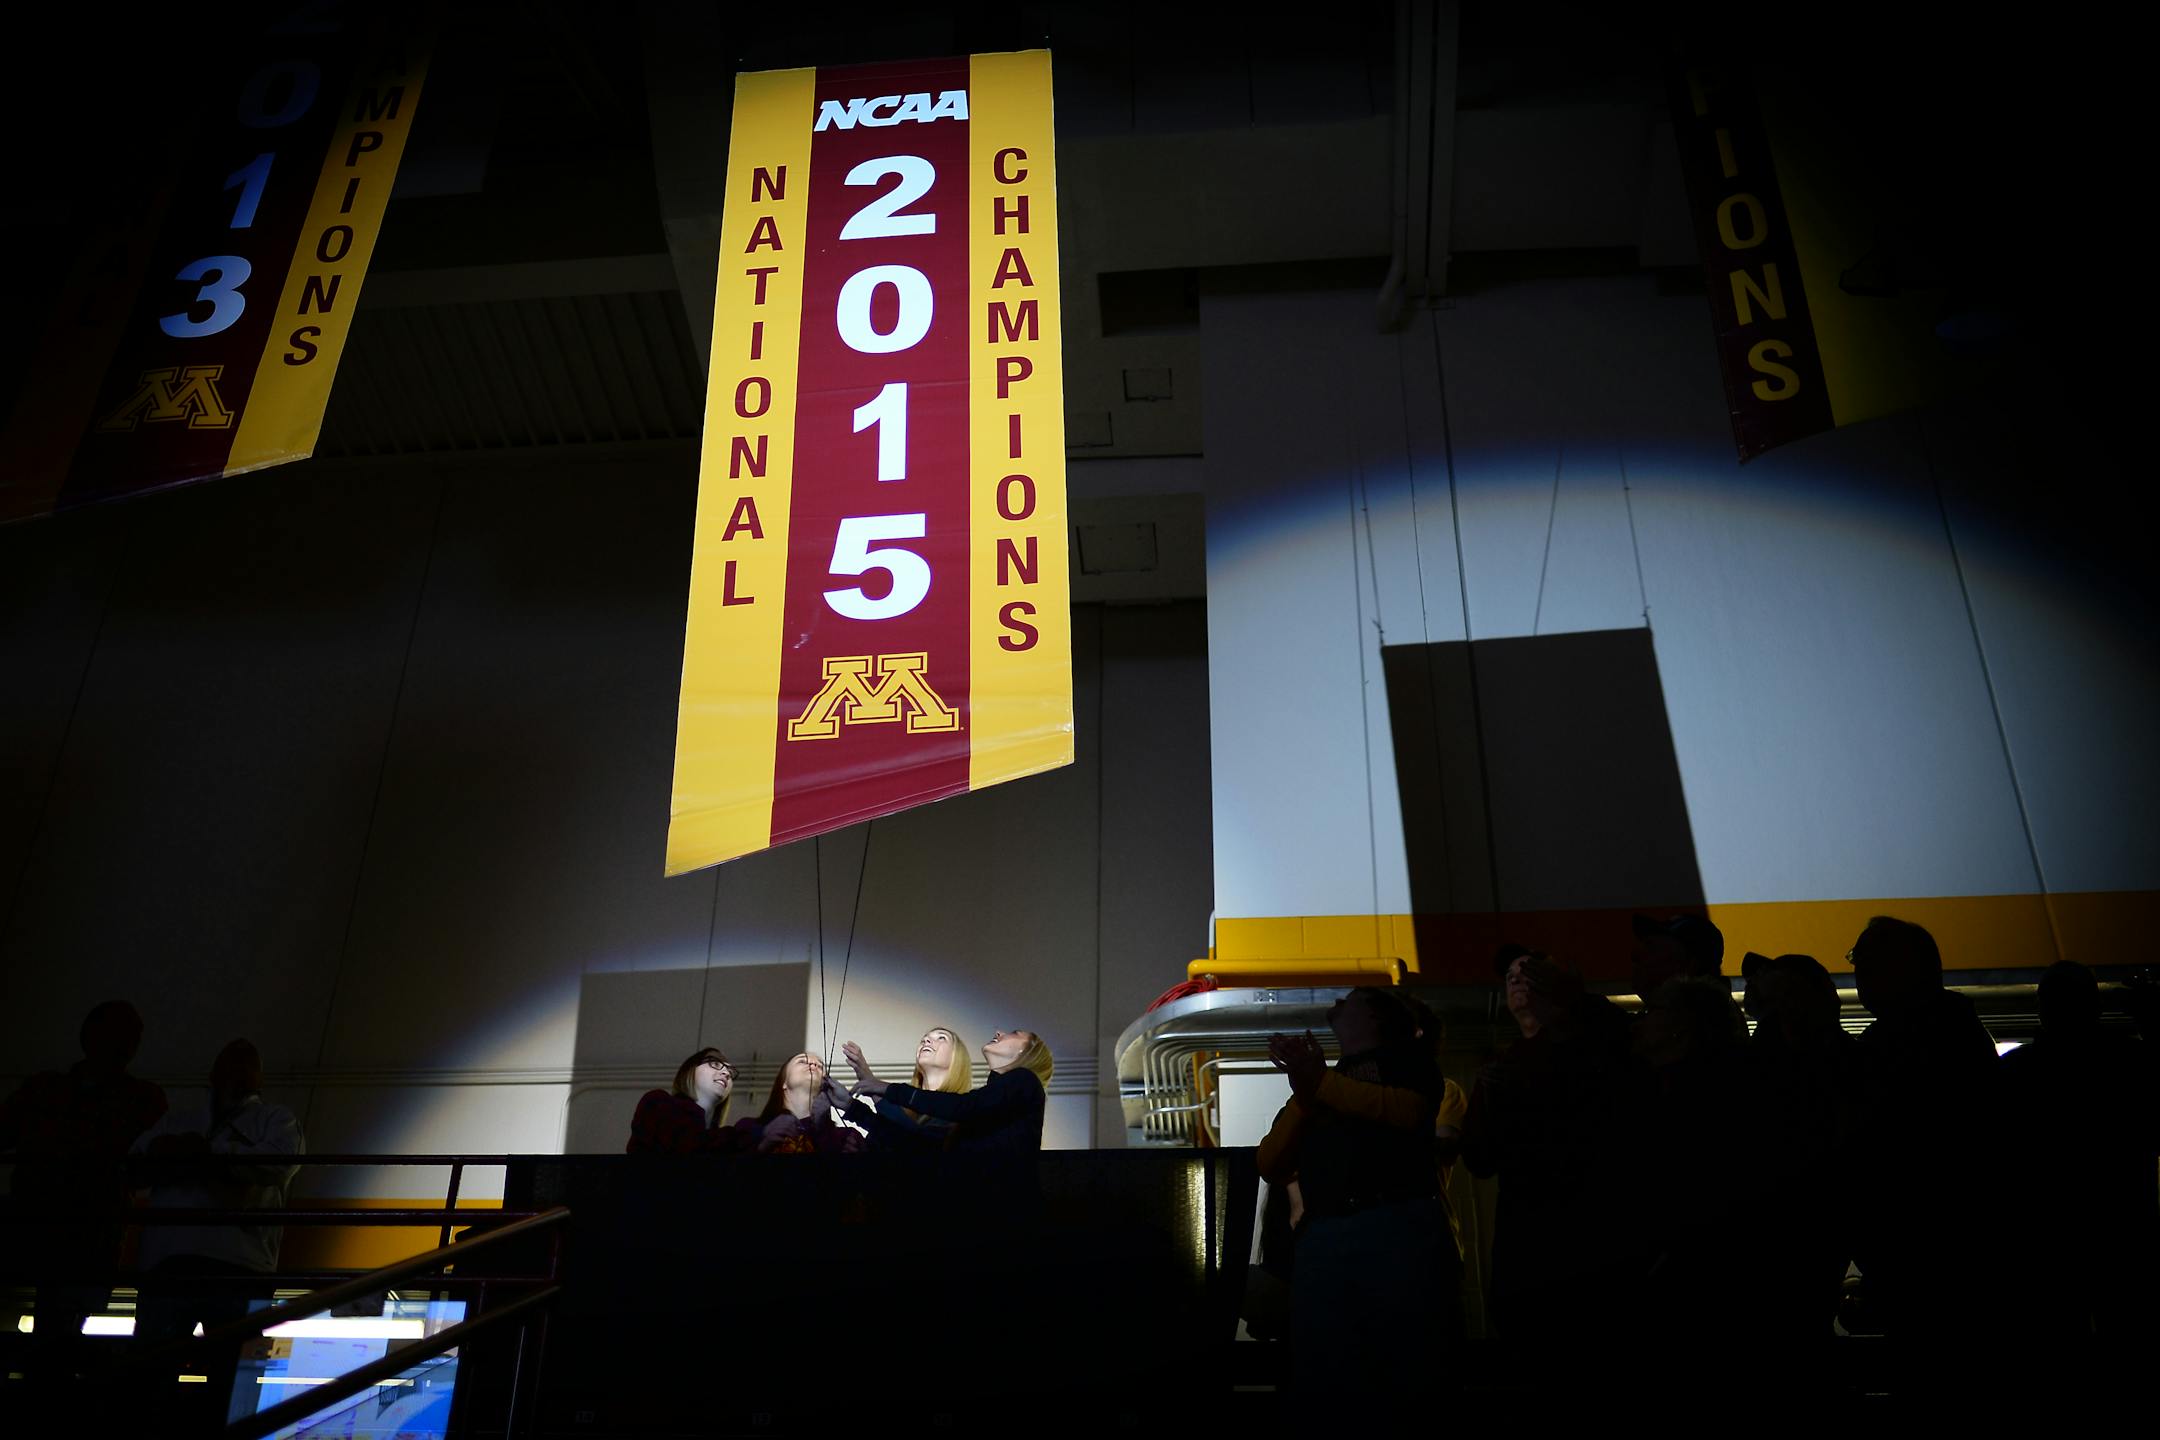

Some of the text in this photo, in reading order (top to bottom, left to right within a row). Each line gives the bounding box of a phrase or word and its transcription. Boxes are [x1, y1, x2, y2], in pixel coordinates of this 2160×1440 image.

[813, 89, 969, 132] NCAA
[722, 165, 787, 606] NATIONAL
[823, 155, 936, 620] 2015
[987, 147, 1039, 651] CHAMPIONS
